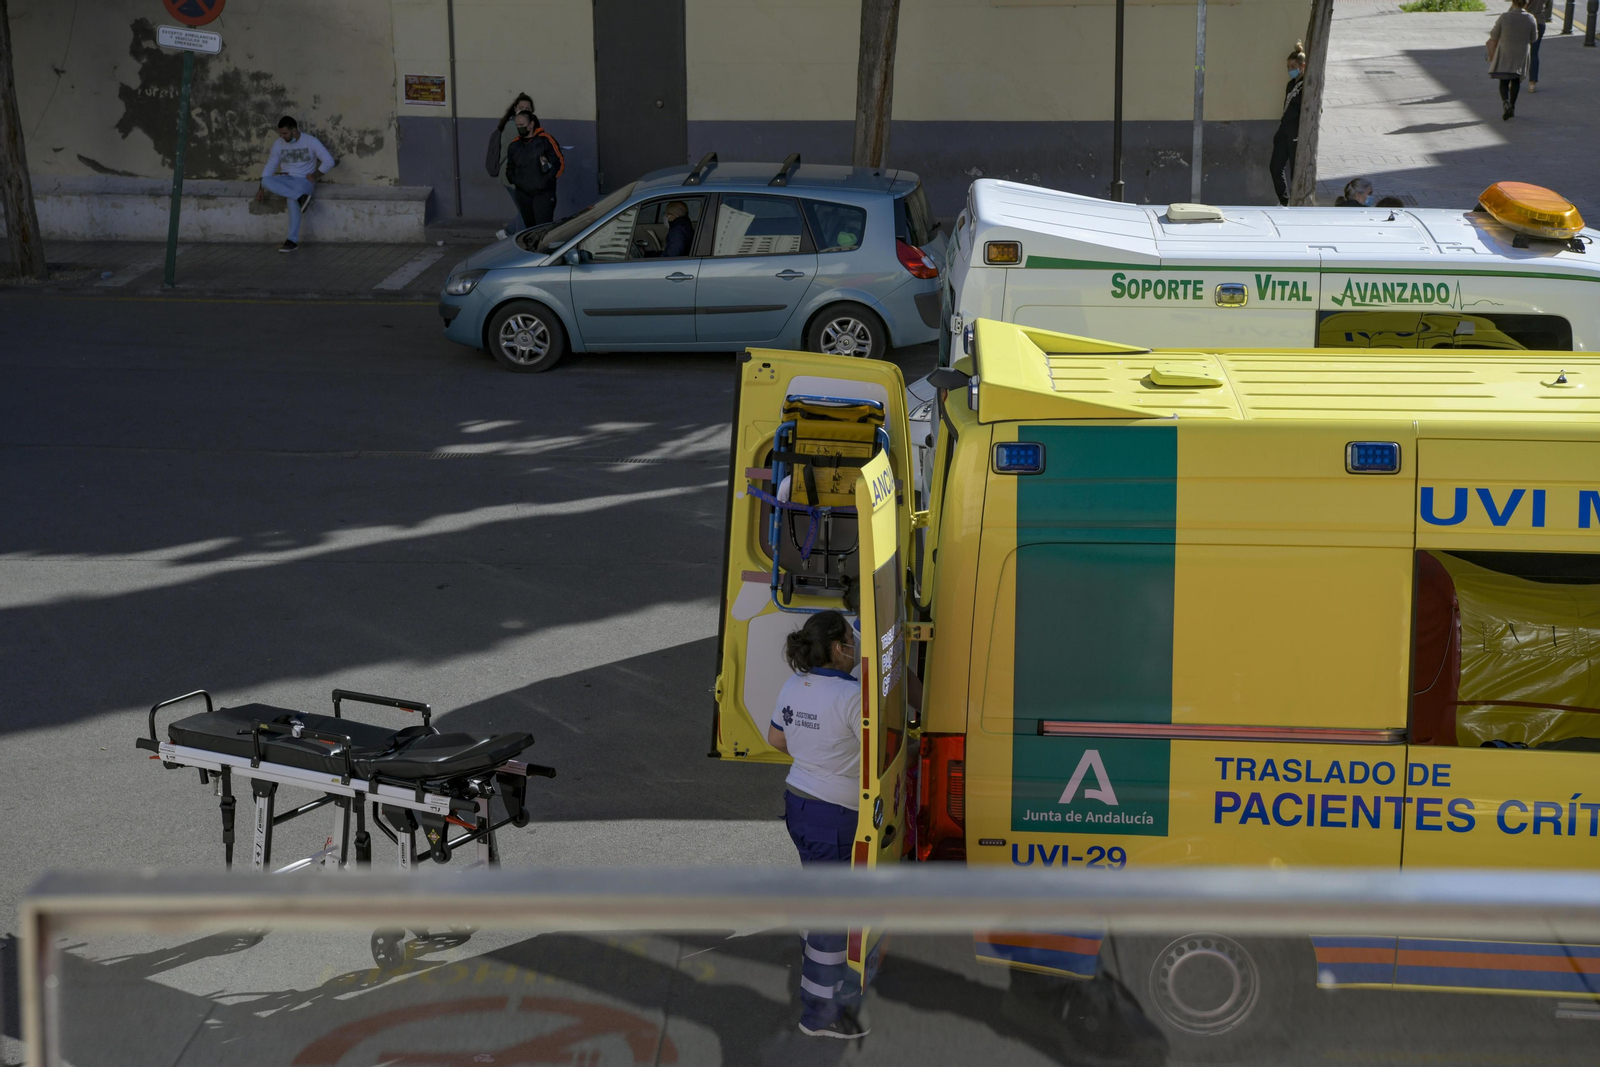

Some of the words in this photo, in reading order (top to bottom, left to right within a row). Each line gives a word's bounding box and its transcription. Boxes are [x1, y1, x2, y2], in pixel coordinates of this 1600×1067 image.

[174, 40, 203, 48] EMERGENCIA
[184, 32, 217, 41] AMBULANCIAS
[1111, 272, 1204, 300] SOPORTE
[1254, 273, 1313, 302] VITAL
[1331, 276, 1450, 306] AVANZADO
[1420, 486, 1546, 527] UVI
[1215, 756, 1396, 786] TRASLADO
[1408, 762, 1452, 787] DE
[1022, 809, 1062, 822] Junta
[1065, 810, 1083, 823] de
[1085, 811, 1154, 825] Andalucía
[1214, 790, 1476, 833] PACIENTES
[1496, 792, 1600, 837] CRÍT
[1011, 843, 1127, 872] UVI-29
